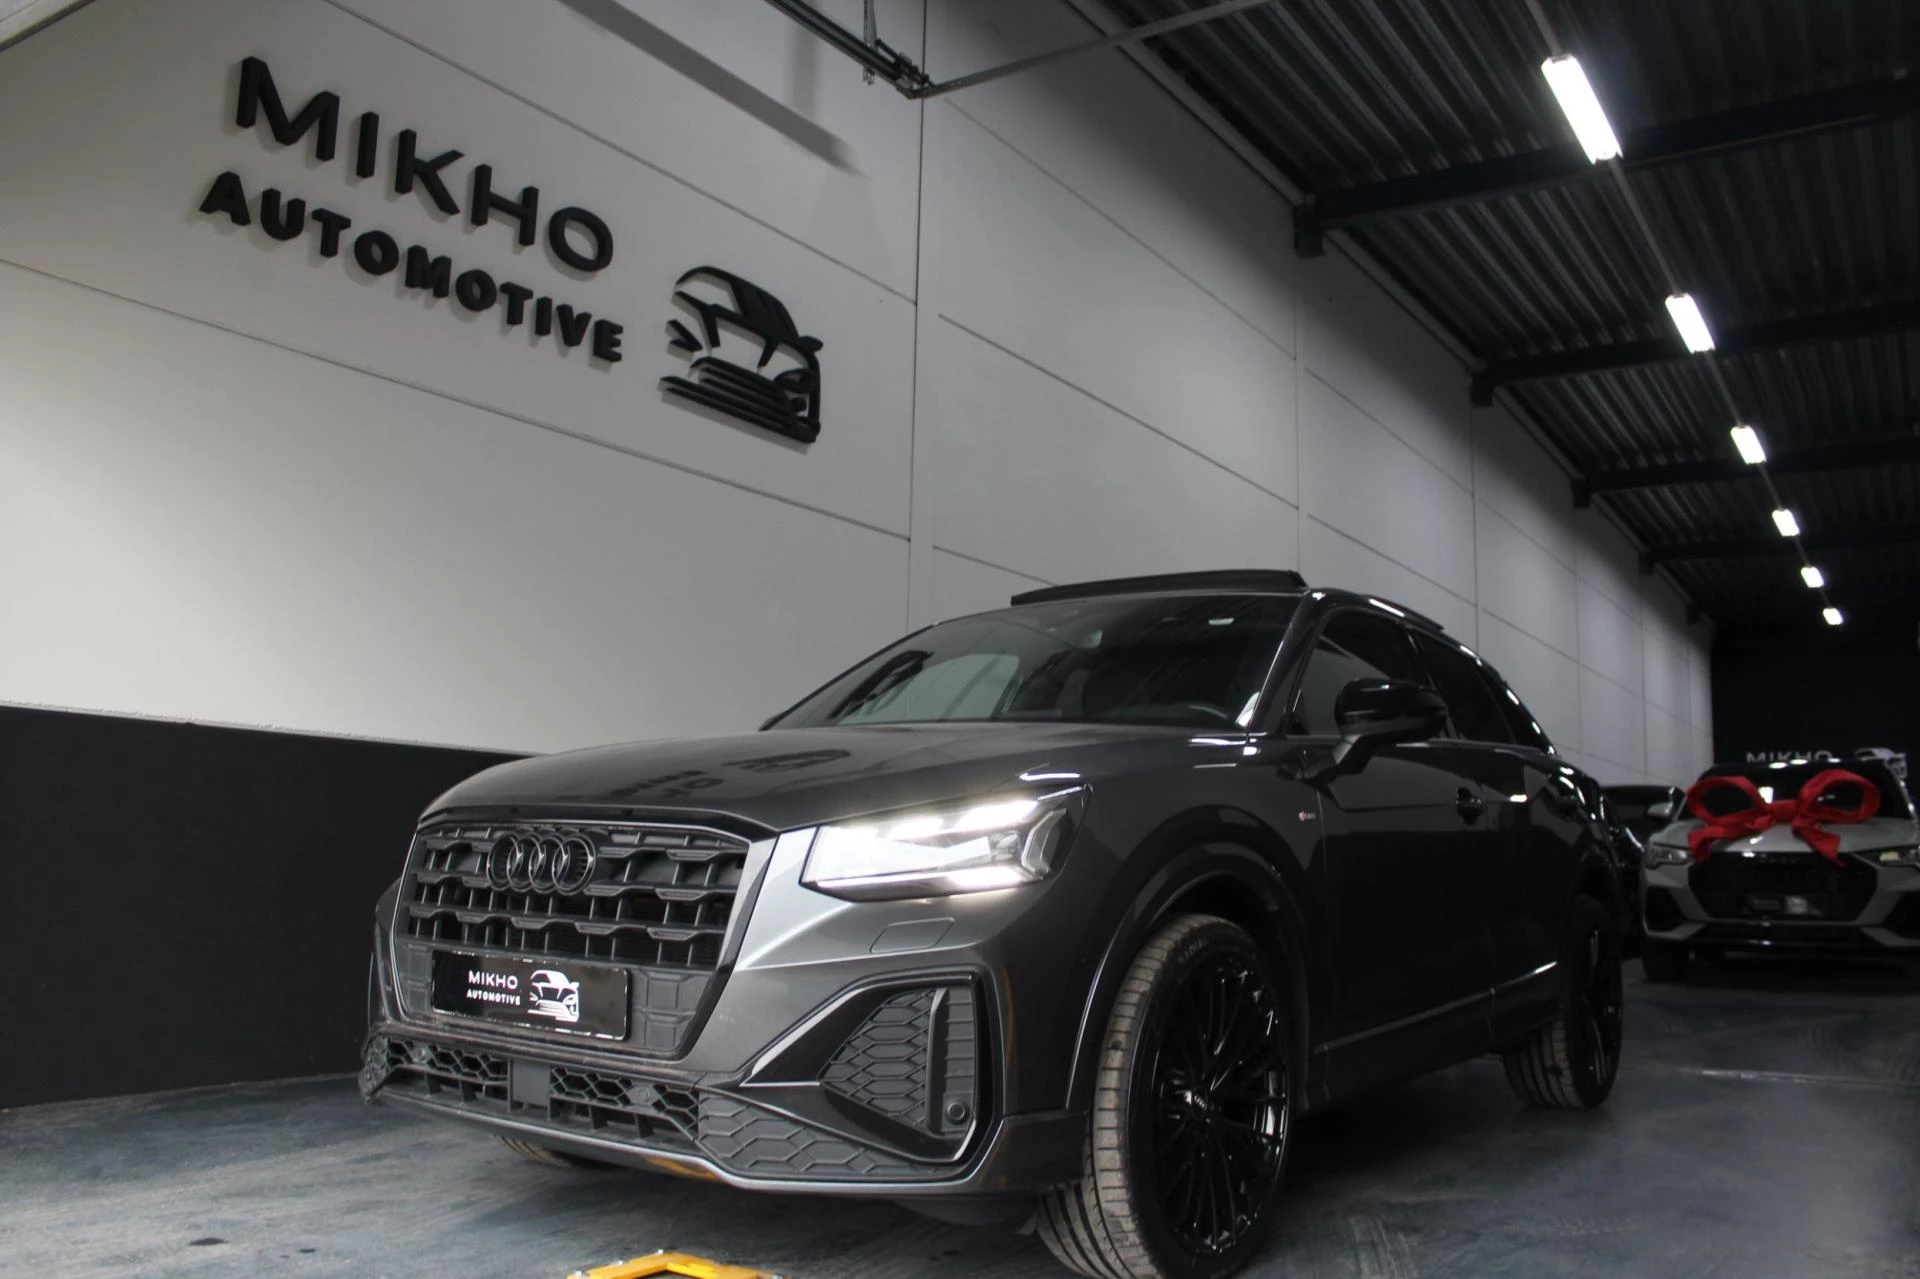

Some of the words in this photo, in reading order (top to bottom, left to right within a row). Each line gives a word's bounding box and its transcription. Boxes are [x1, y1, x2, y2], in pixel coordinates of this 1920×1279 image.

[236, 56, 613, 272] MIKHO
[199, 171, 624, 362] AUTOMOTIVE
[466, 989, 520, 1006] AUTOMOTIVE
[468, 969, 518, 989] MIKHO
